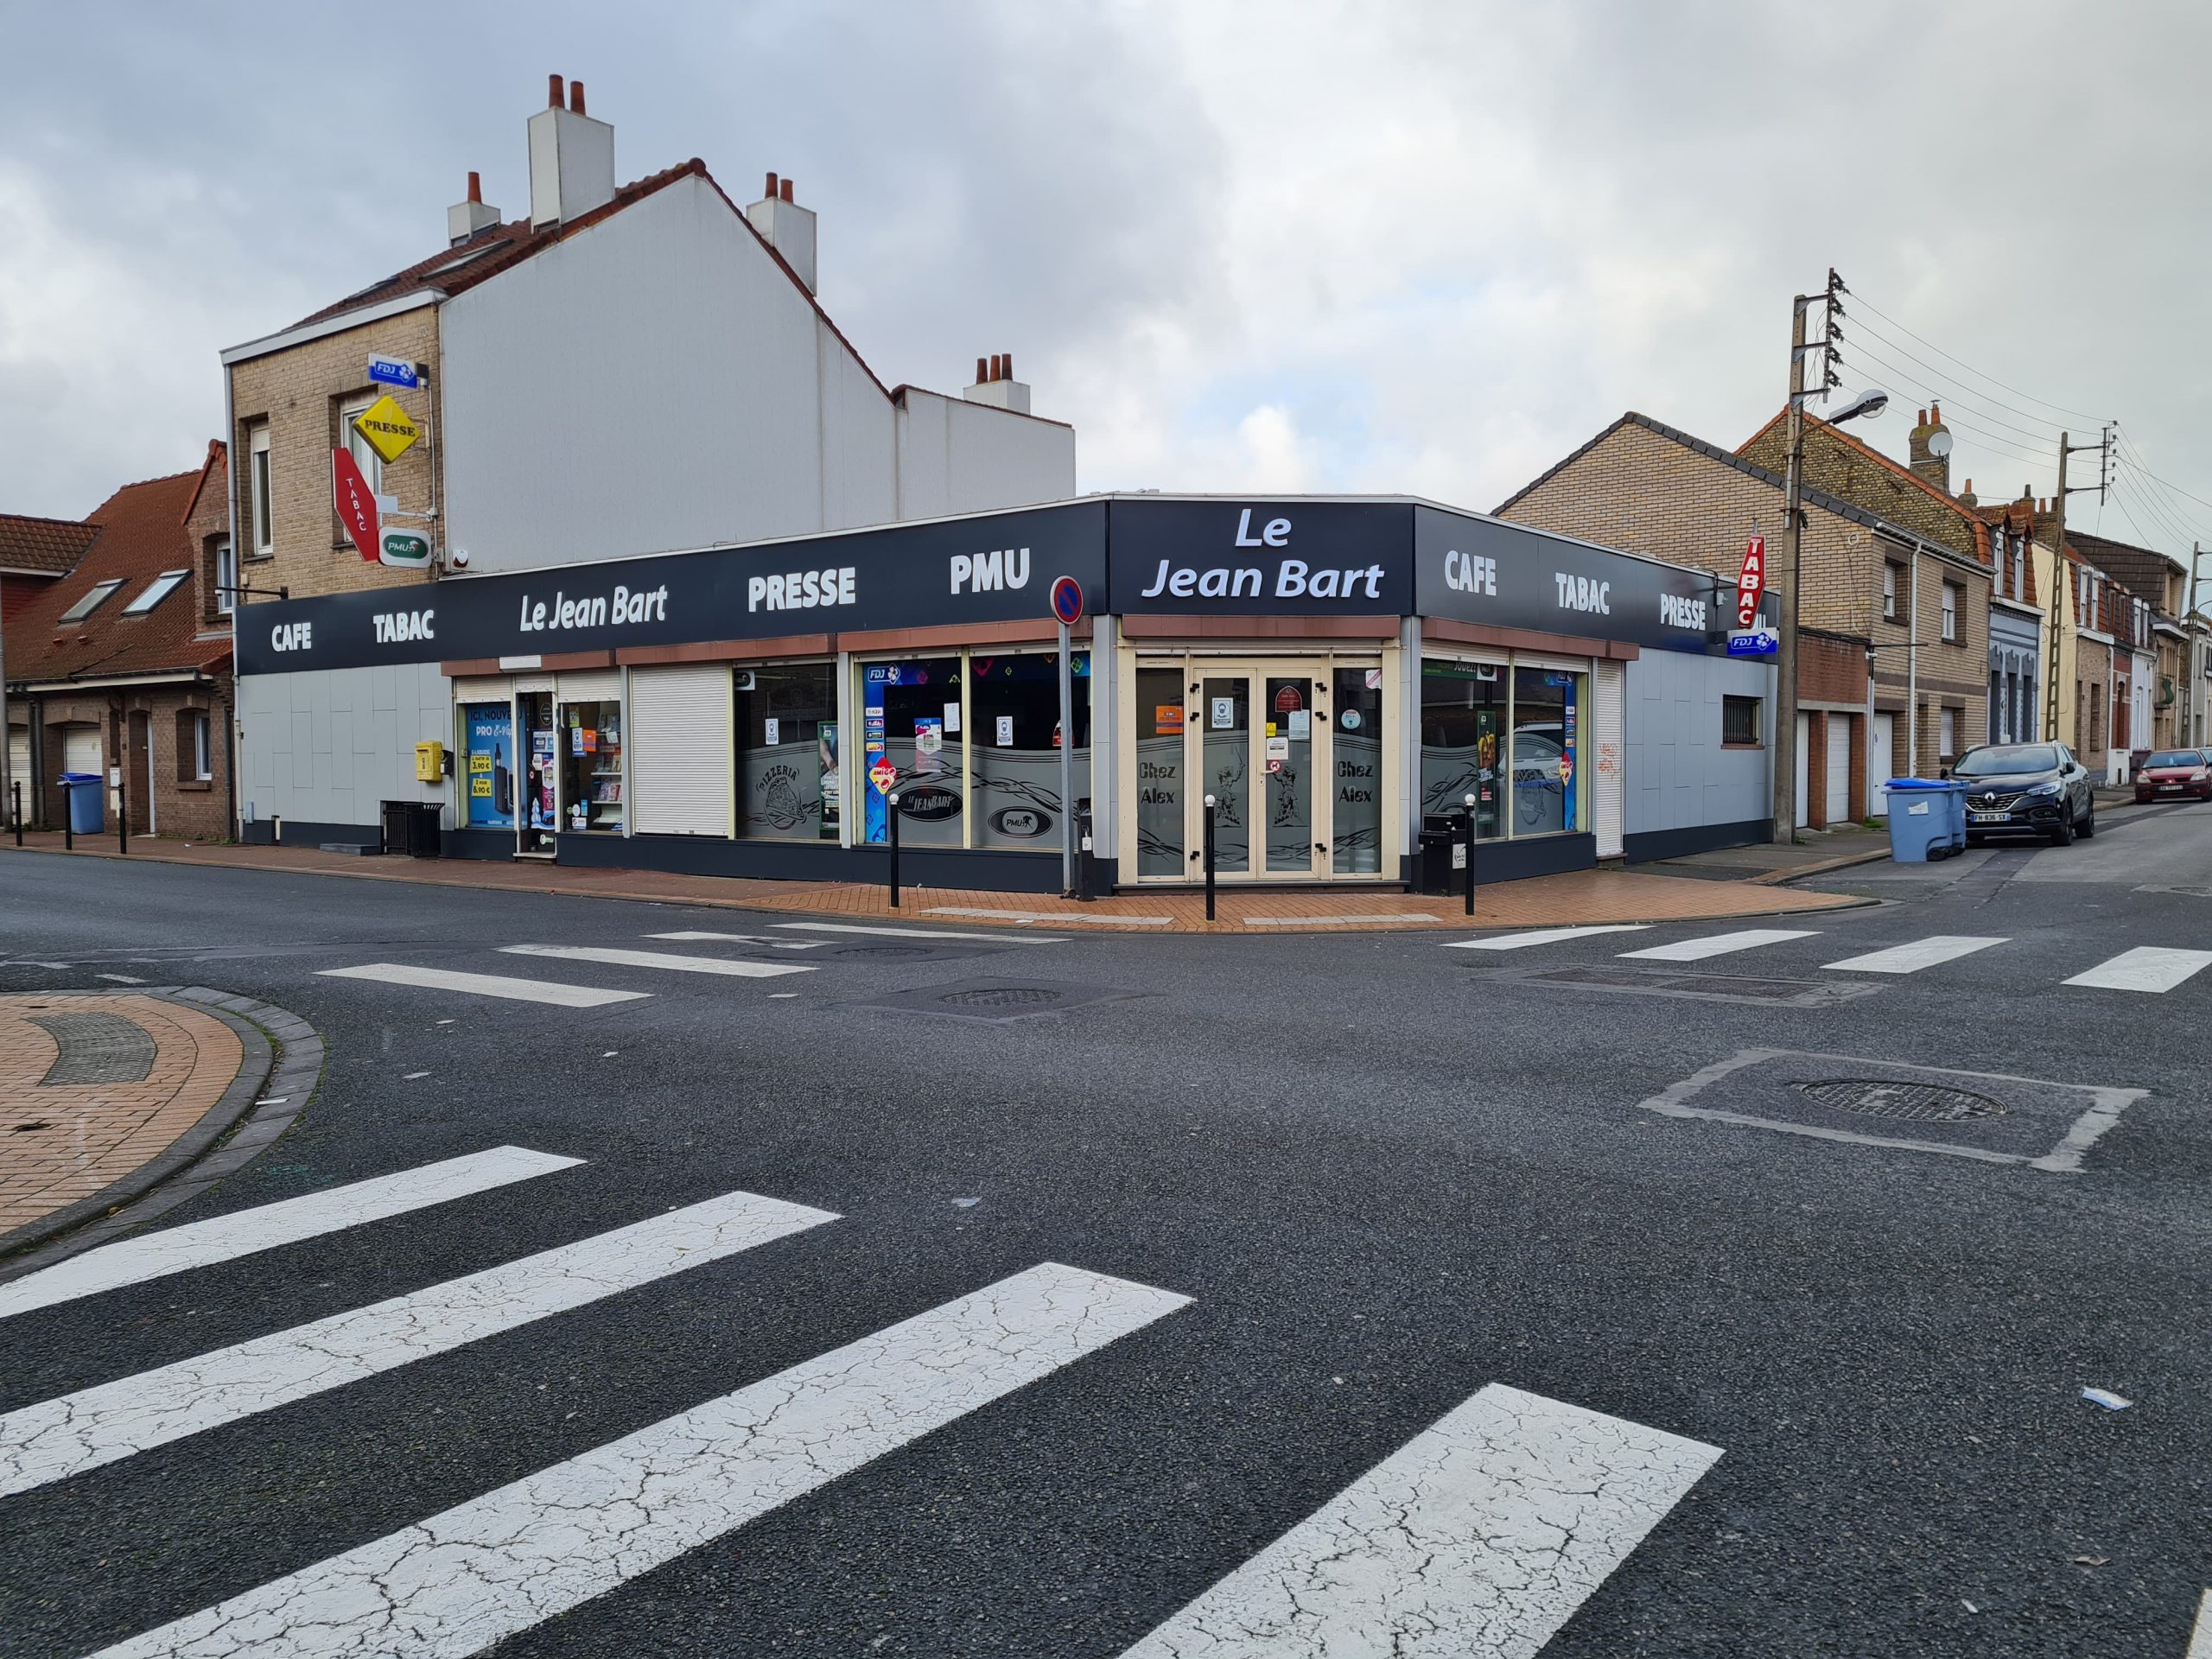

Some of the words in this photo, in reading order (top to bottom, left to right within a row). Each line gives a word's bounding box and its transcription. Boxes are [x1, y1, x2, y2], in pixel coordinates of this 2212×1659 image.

[377, 363, 396, 374] FDJ
[364, 418, 416, 437] PRESSE
[346, 478, 367, 531] TABAC
[1236, 508, 1292, 547] Le
[387, 542, 410, 552] PMU
[950, 547, 1030, 595] PMU
[1141, 559, 1262, 598] Jean
[1274, 559, 1385, 599] Bart
[1444, 550, 1497, 596] CAFE
[1738, 538, 1762, 624] TABAC
[748, 566, 856, 613] PRESSE
[1555, 572, 1610, 615] TABAC
[519, 594, 547, 632] Le
[548, 591, 607, 630] Jean
[611, 584, 668, 625] Bart
[1660, 593, 1706, 631] PRESSE
[271, 621, 312, 652] CAFE
[372, 609, 435, 644] TABAC
[1733, 638, 1753, 647] FDJ
[870, 669, 886, 679] FDJ
[484, 709, 523, 721] NOUVEU
[476, 726, 492, 736] PRO
[759, 765, 798, 791] PIZZERIA
[1139, 762, 1176, 779] Chez
[1338, 760, 1373, 778] Chez
[1141, 787, 1175, 804] Alex
[1338, 785, 1373, 803] Alex
[1006, 818, 1022, 827] PMU
